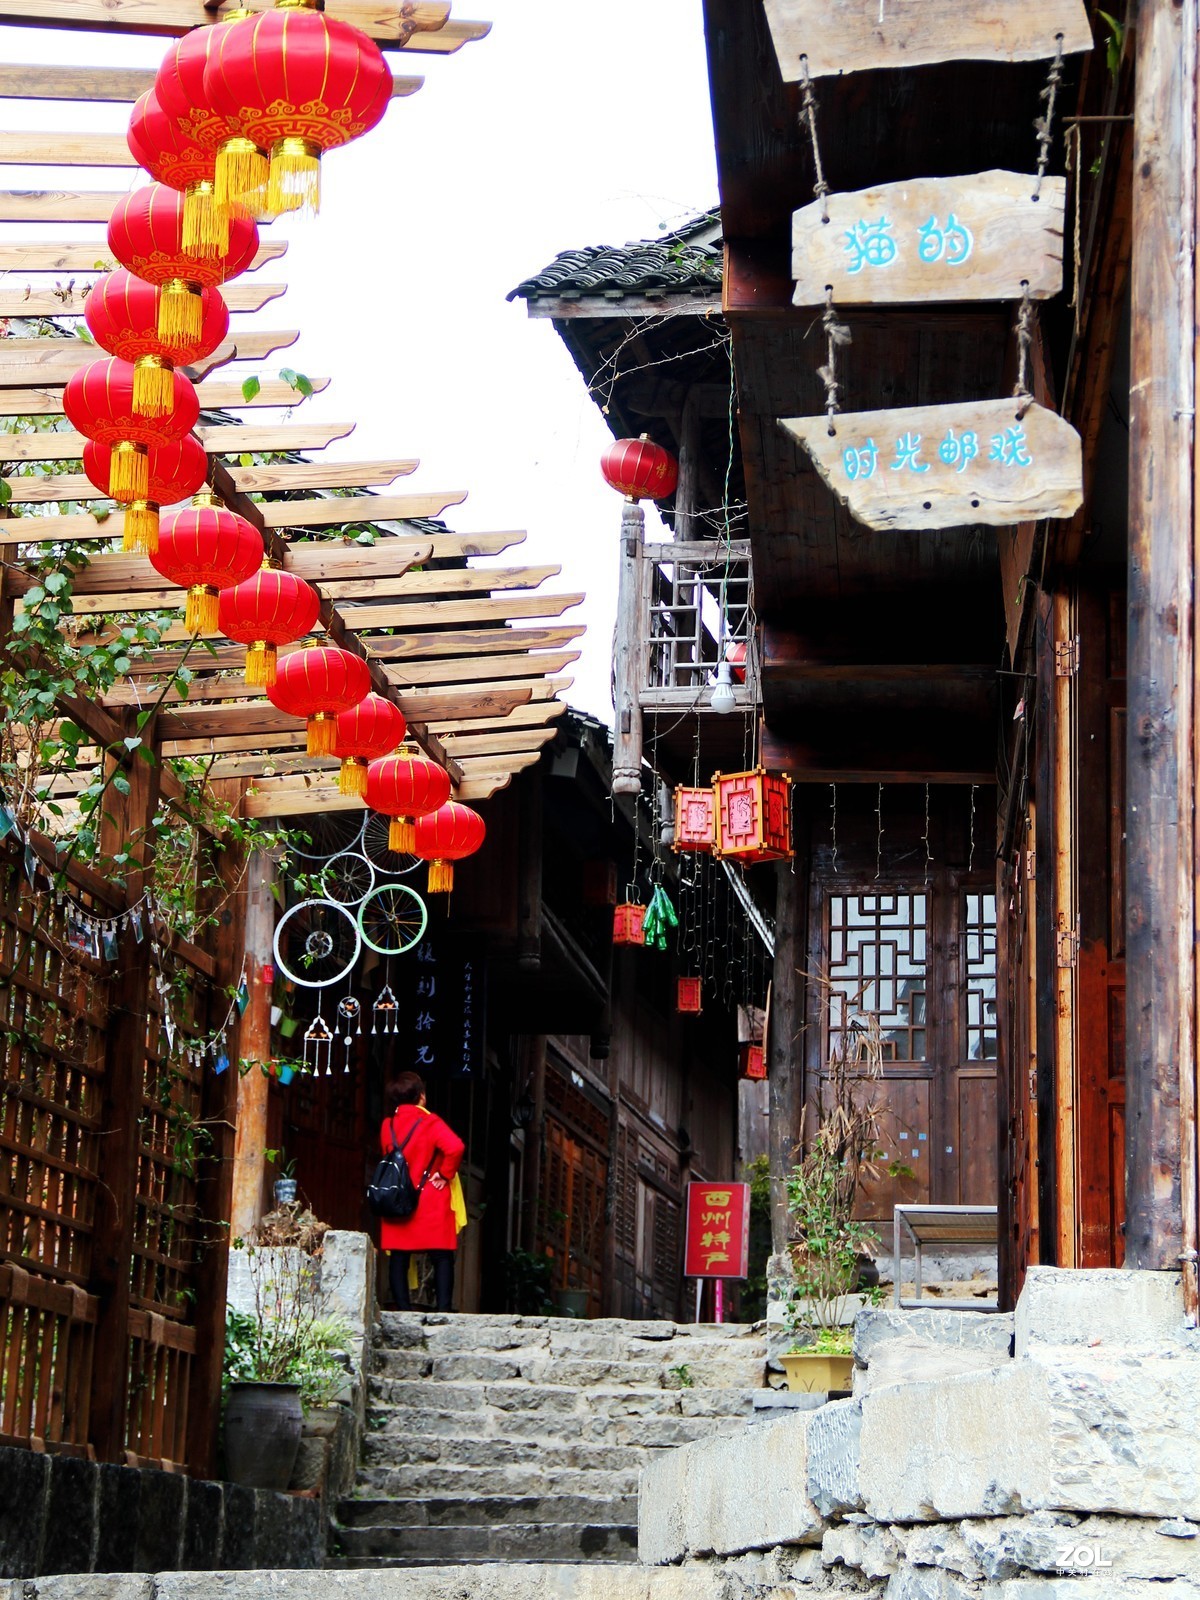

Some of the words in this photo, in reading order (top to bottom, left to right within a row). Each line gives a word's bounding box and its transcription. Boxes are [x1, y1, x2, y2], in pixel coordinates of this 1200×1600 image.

[844, 214, 974, 275] 猫的
[842, 425, 1033, 481] 时光邮戏
